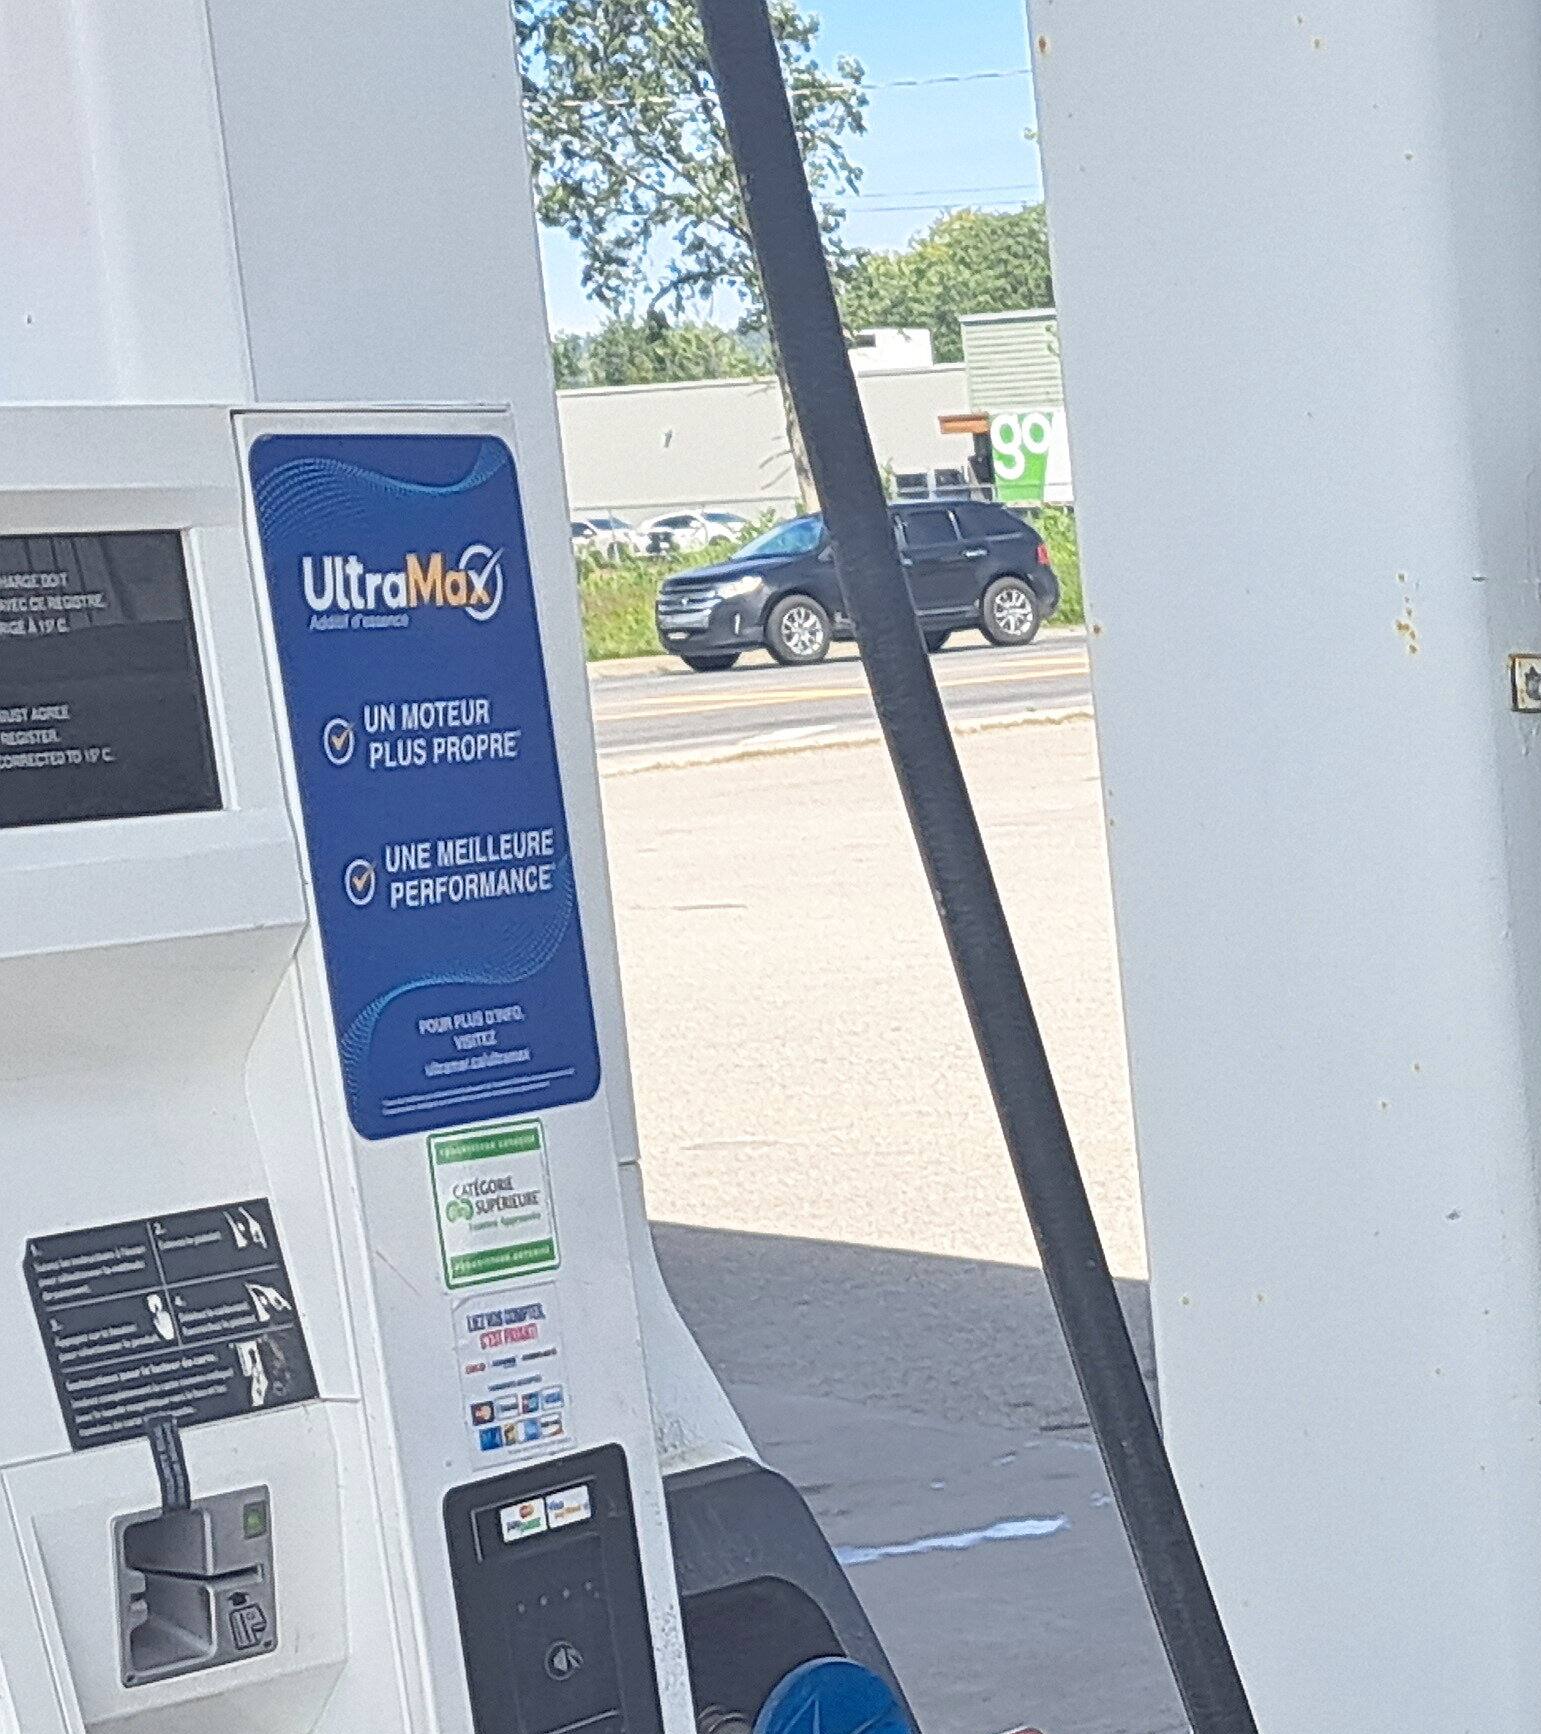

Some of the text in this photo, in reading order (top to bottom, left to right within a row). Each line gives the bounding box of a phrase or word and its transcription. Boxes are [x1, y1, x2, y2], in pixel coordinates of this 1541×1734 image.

[302, 547, 503, 613] UltraMax
[363, 699, 490, 733] UN MOTEUR
[369, 731, 519, 768] PLUS PROPRE
[385, 828, 554, 871] UNE MEILLEURE
[390, 864, 553, 908] PERFORMANCE
